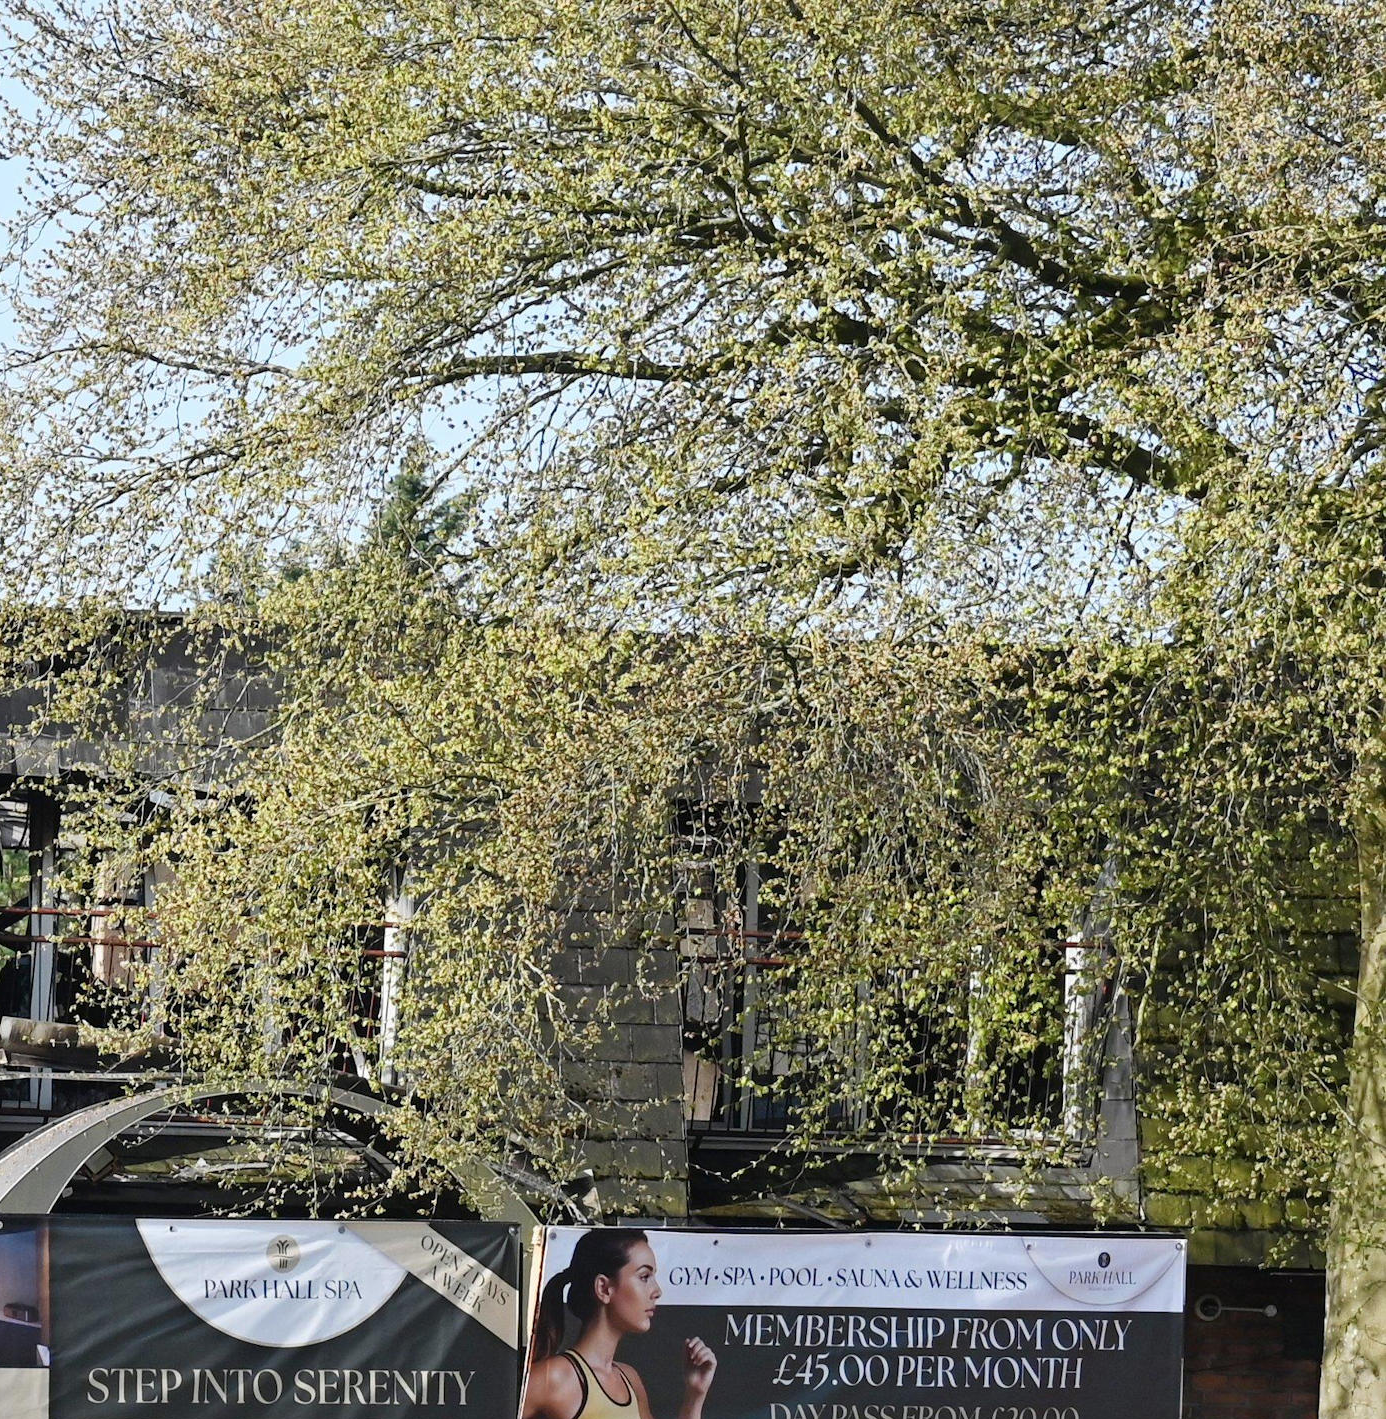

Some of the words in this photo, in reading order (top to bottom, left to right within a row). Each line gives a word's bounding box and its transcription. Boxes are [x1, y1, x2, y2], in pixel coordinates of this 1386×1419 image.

[421, 1235, 462, 1271] OPEN
[463, 1264, 474, 1277] 7
[472, 1272, 509, 1305] DAYS
[424, 1265, 437, 1280] A
[443, 1273, 485, 1312] WEEK
[669, 1266, 711, 1286] GYM
[722, 1266, 756, 1286] SPA
[769, 1267, 823, 1287] POOL
[835, 1268, 901, 1288] SAUNA
[904, 1269, 922, 1288] &
[926, 1269, 1028, 1291] WELLNESS
[1069, 1270, 1099, 1285] PARK
[1102, 1270, 1137, 1285] HALL
[203, 1279, 257, 1299] PARK
[263, 1280, 320, 1300] HALL
[324, 1280, 363, 1300] SPA
[724, 1313, 945, 1349] MEMBERSHIP
[950, 1316, 1044, 1350] FROM
[1051, 1318, 1132, 1350] ONLY
[87, 1368, 182, 1404] STEP
[193, 1369, 283, 1405] INTO
[294, 1370, 475, 1406] SERENITY
[772, 1352, 890, 1390] £45.00
[896, 1355, 957, 1388] PER
[964, 1356, 1083, 1389] MONTH
